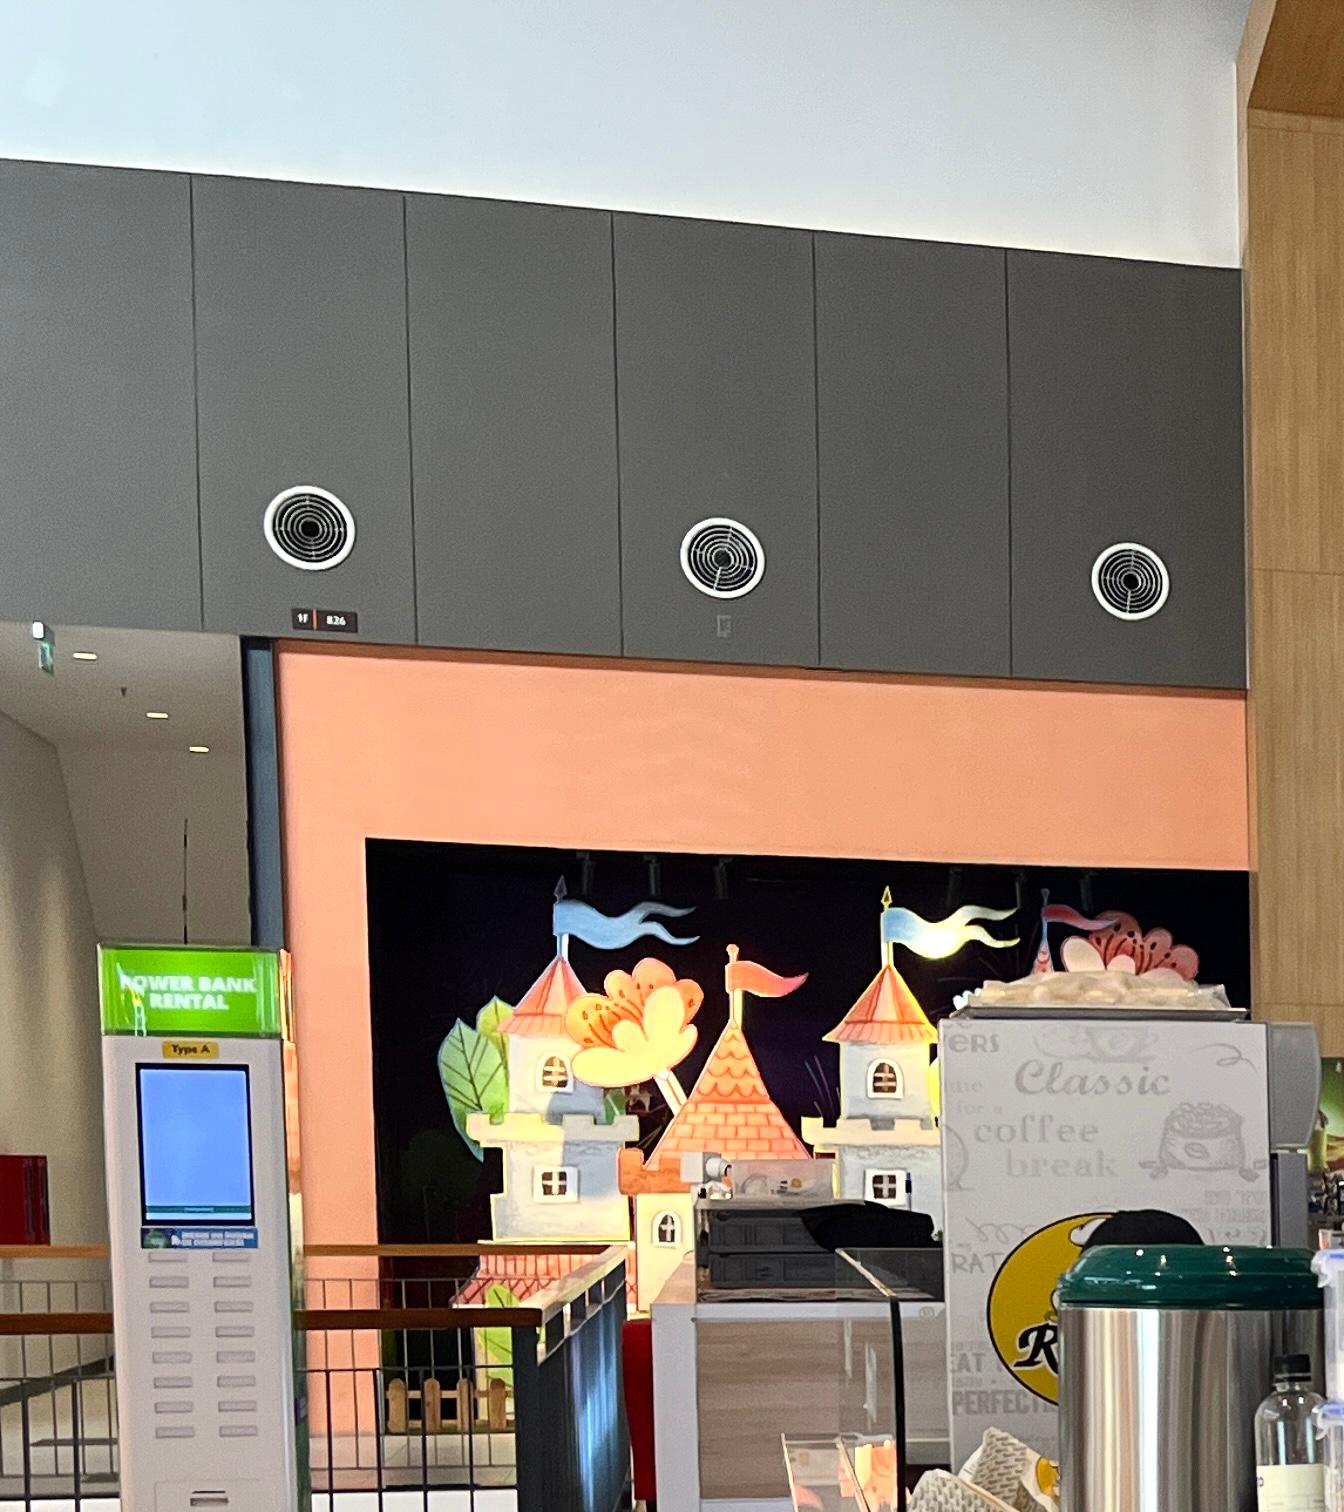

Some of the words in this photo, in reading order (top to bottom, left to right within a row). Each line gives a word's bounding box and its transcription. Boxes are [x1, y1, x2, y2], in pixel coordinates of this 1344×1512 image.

[200, 976, 257, 992] BANK
[150, 993, 229, 1010] RENTAL
[171, 1044, 198, 1055] Type
[200, 1044, 210, 1054] A
[1015, 1059, 1171, 1096] Classic
[974, 1115, 1100, 1143] coffee
[1006, 1150, 1119, 1178] break
